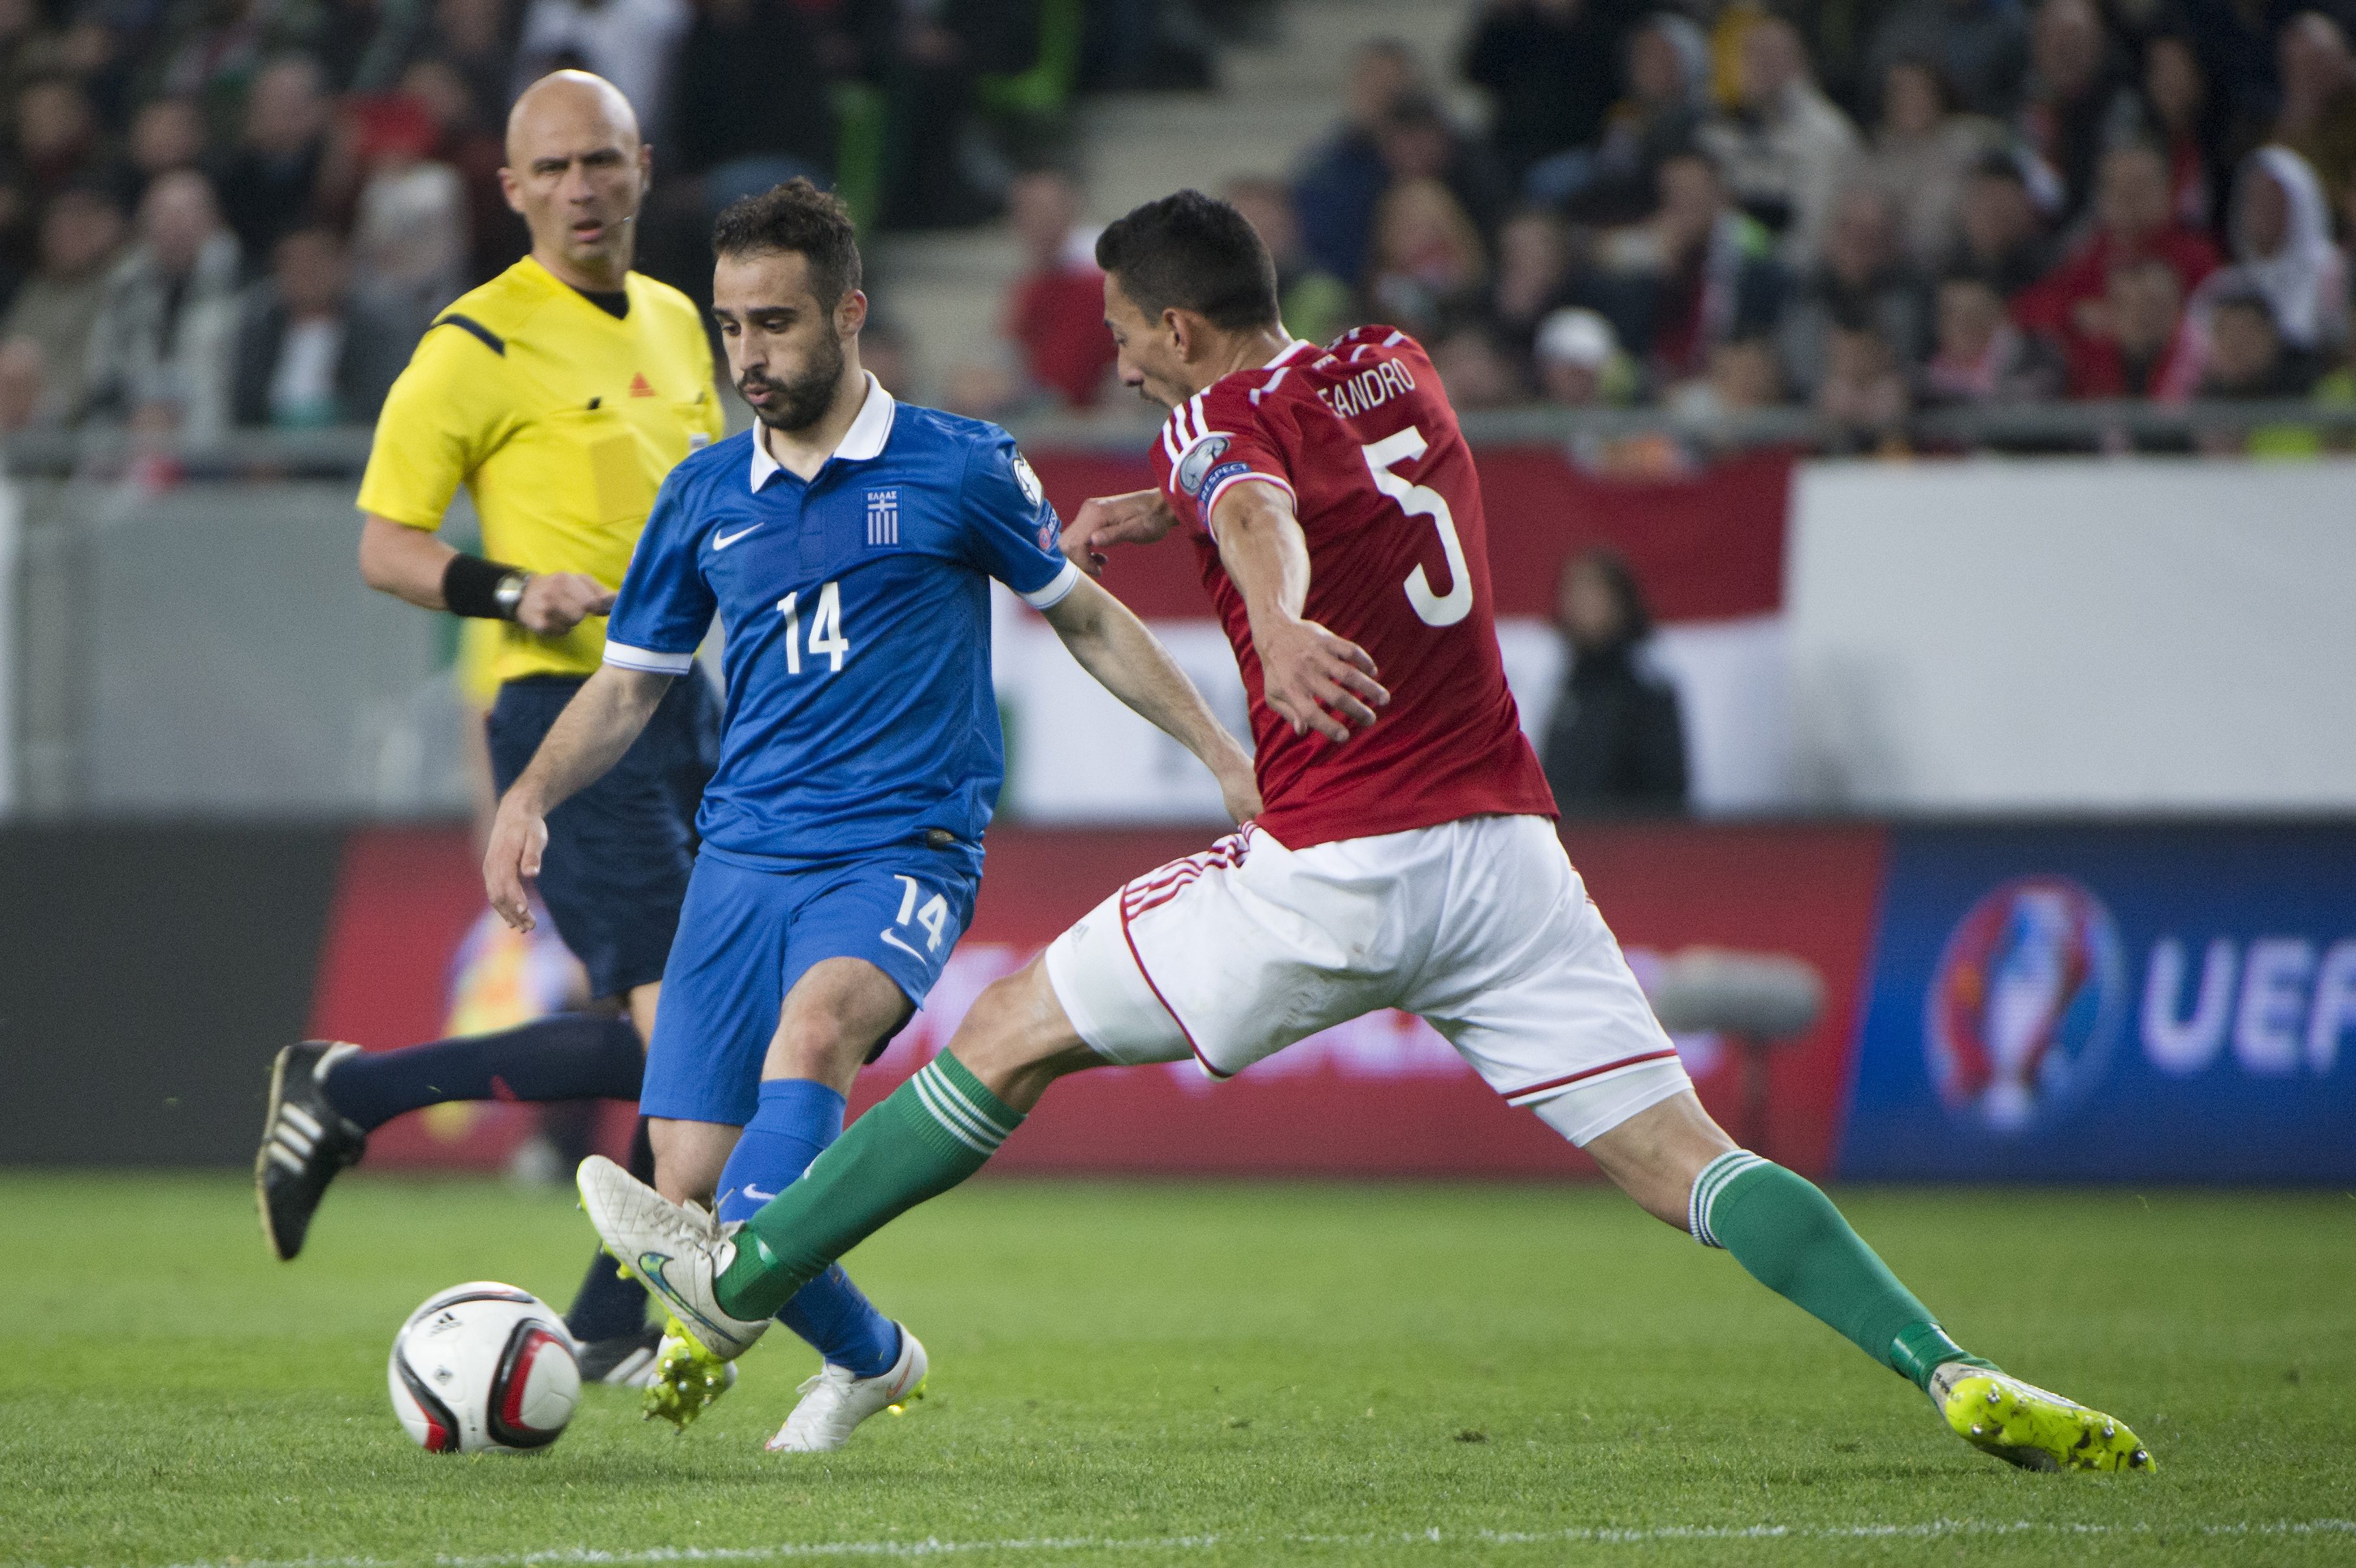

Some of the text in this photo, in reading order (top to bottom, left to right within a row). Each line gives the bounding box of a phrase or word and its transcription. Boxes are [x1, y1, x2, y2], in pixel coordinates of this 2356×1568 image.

[1362, 426, 1473, 627] 5
[777, 582, 849, 674] 14
[894, 873, 948, 953] 14
